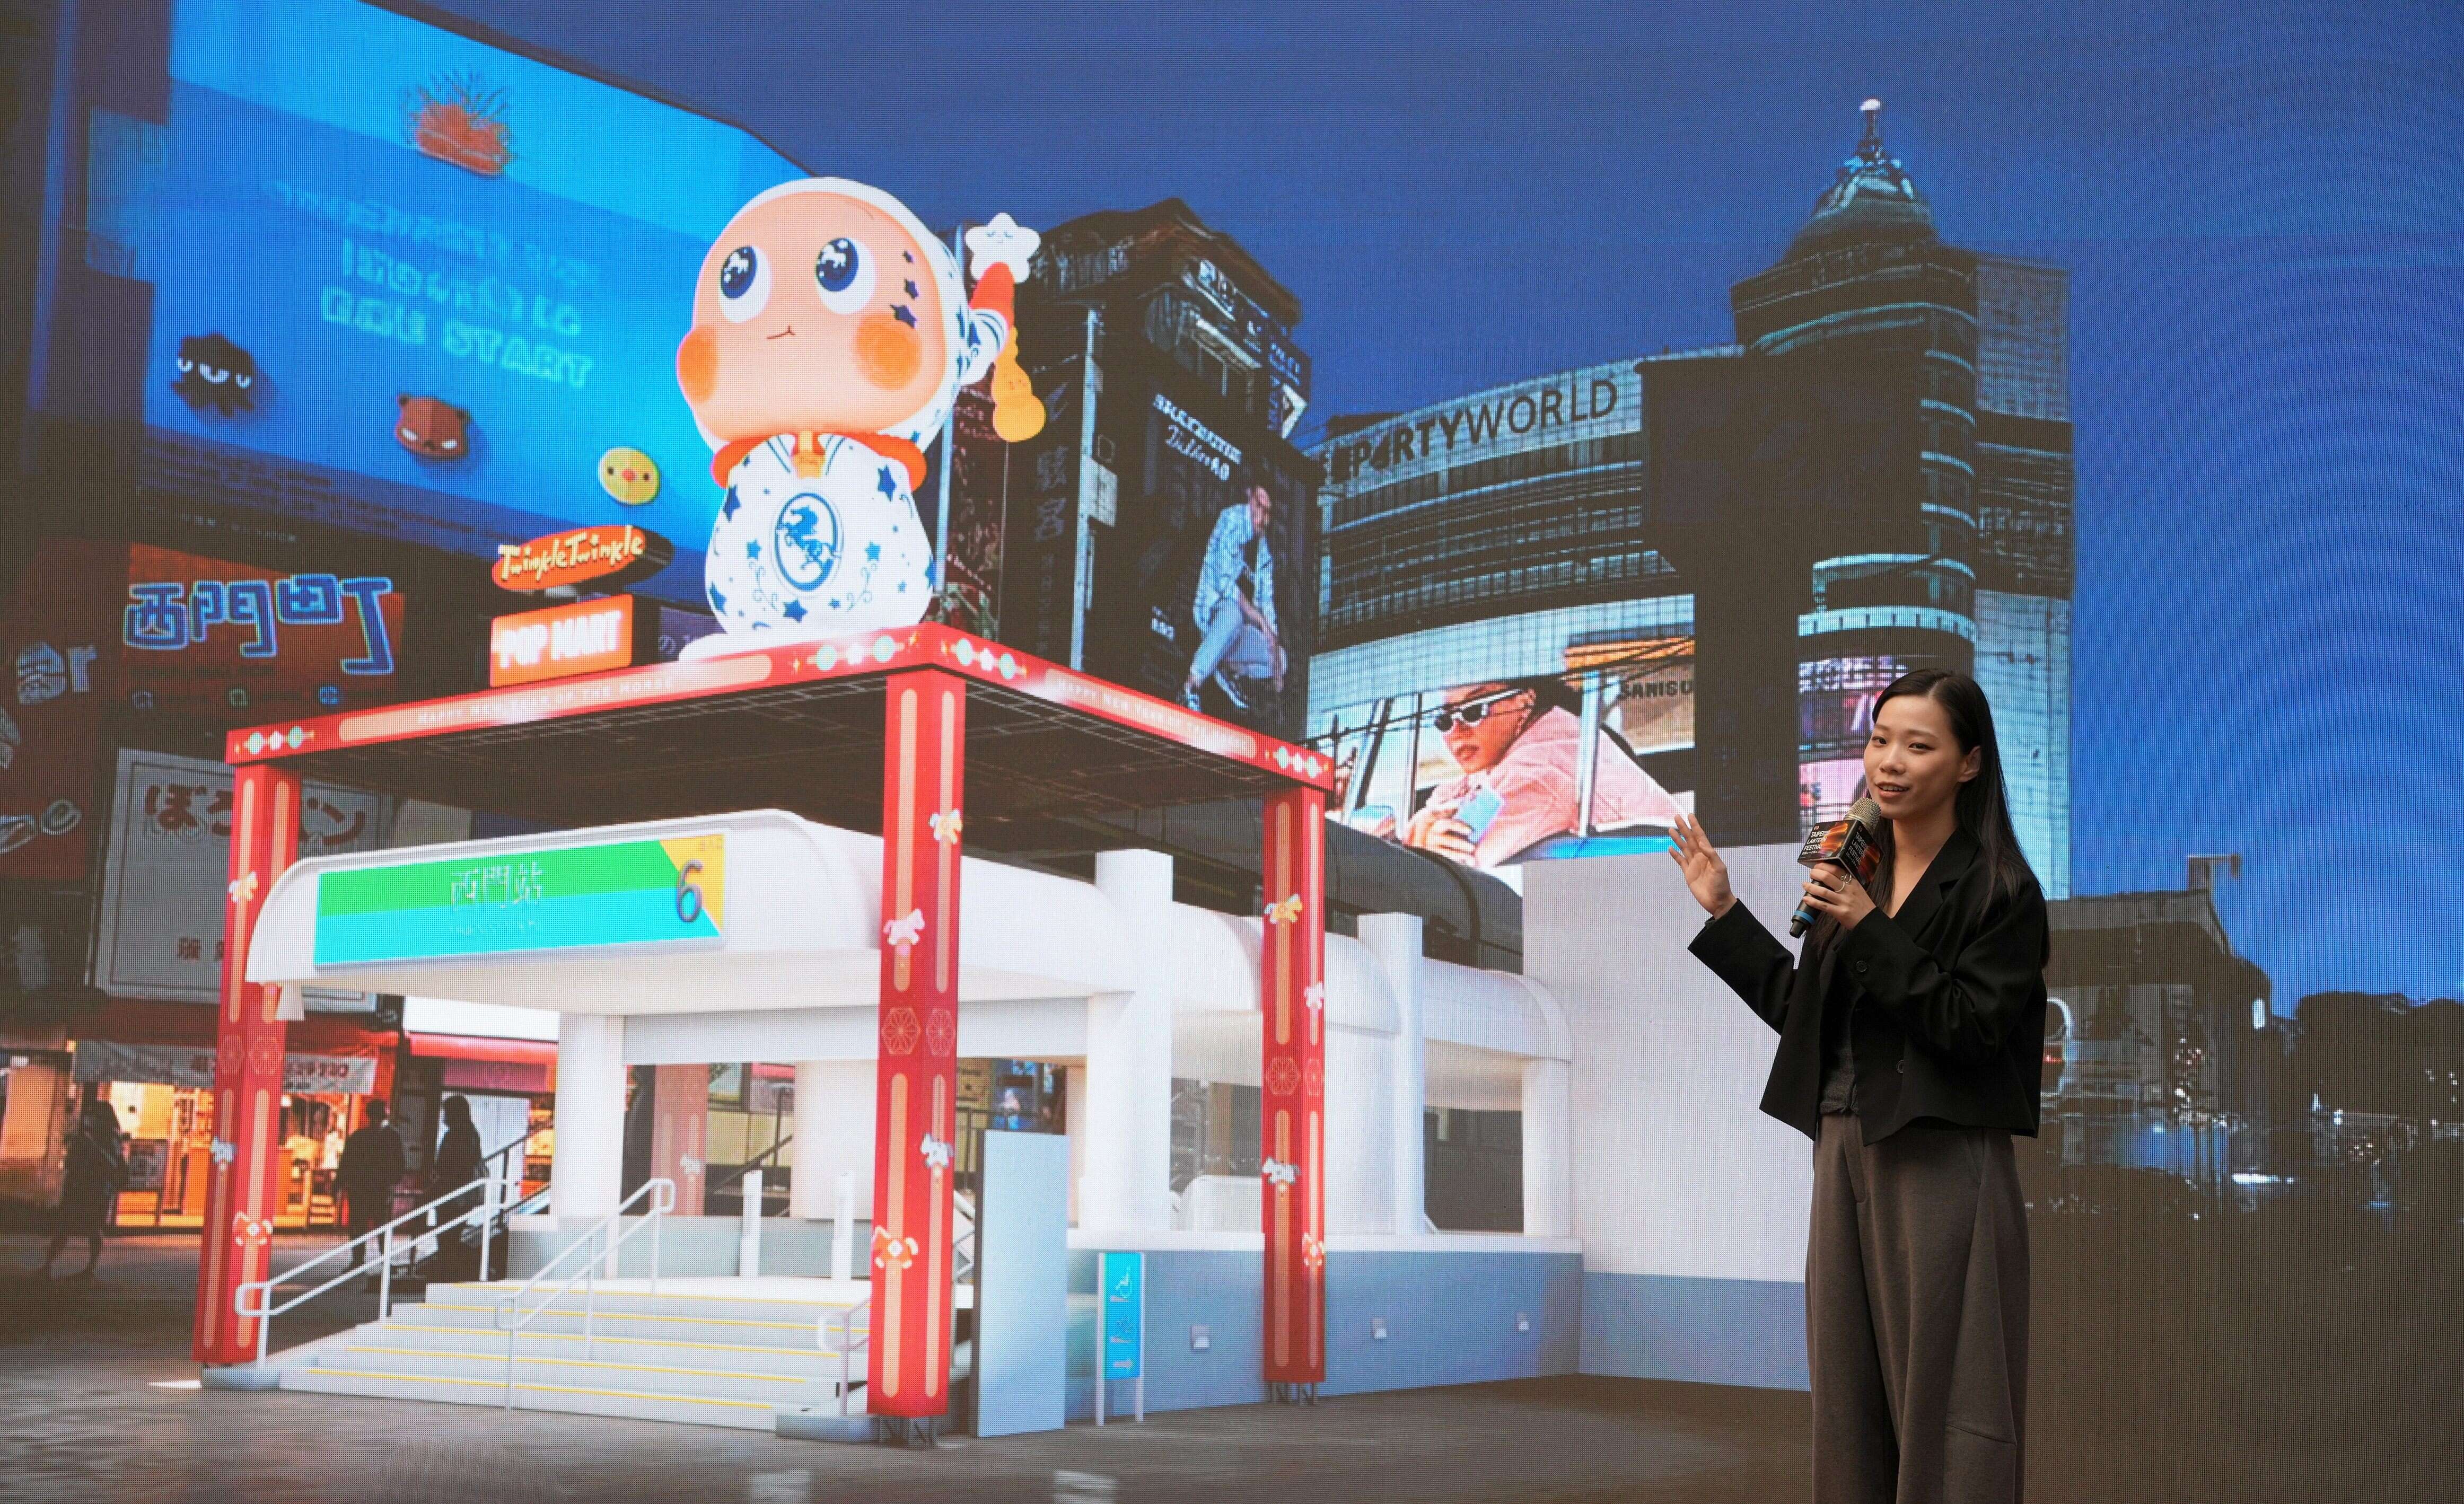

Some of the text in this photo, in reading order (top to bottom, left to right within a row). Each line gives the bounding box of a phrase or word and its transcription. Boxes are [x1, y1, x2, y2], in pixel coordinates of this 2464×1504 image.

[124, 573, 394, 675] 西門町
[499, 610, 622, 667] POP MART
[450, 861, 543, 912] 西門站
[675, 859, 703, 924] 6
